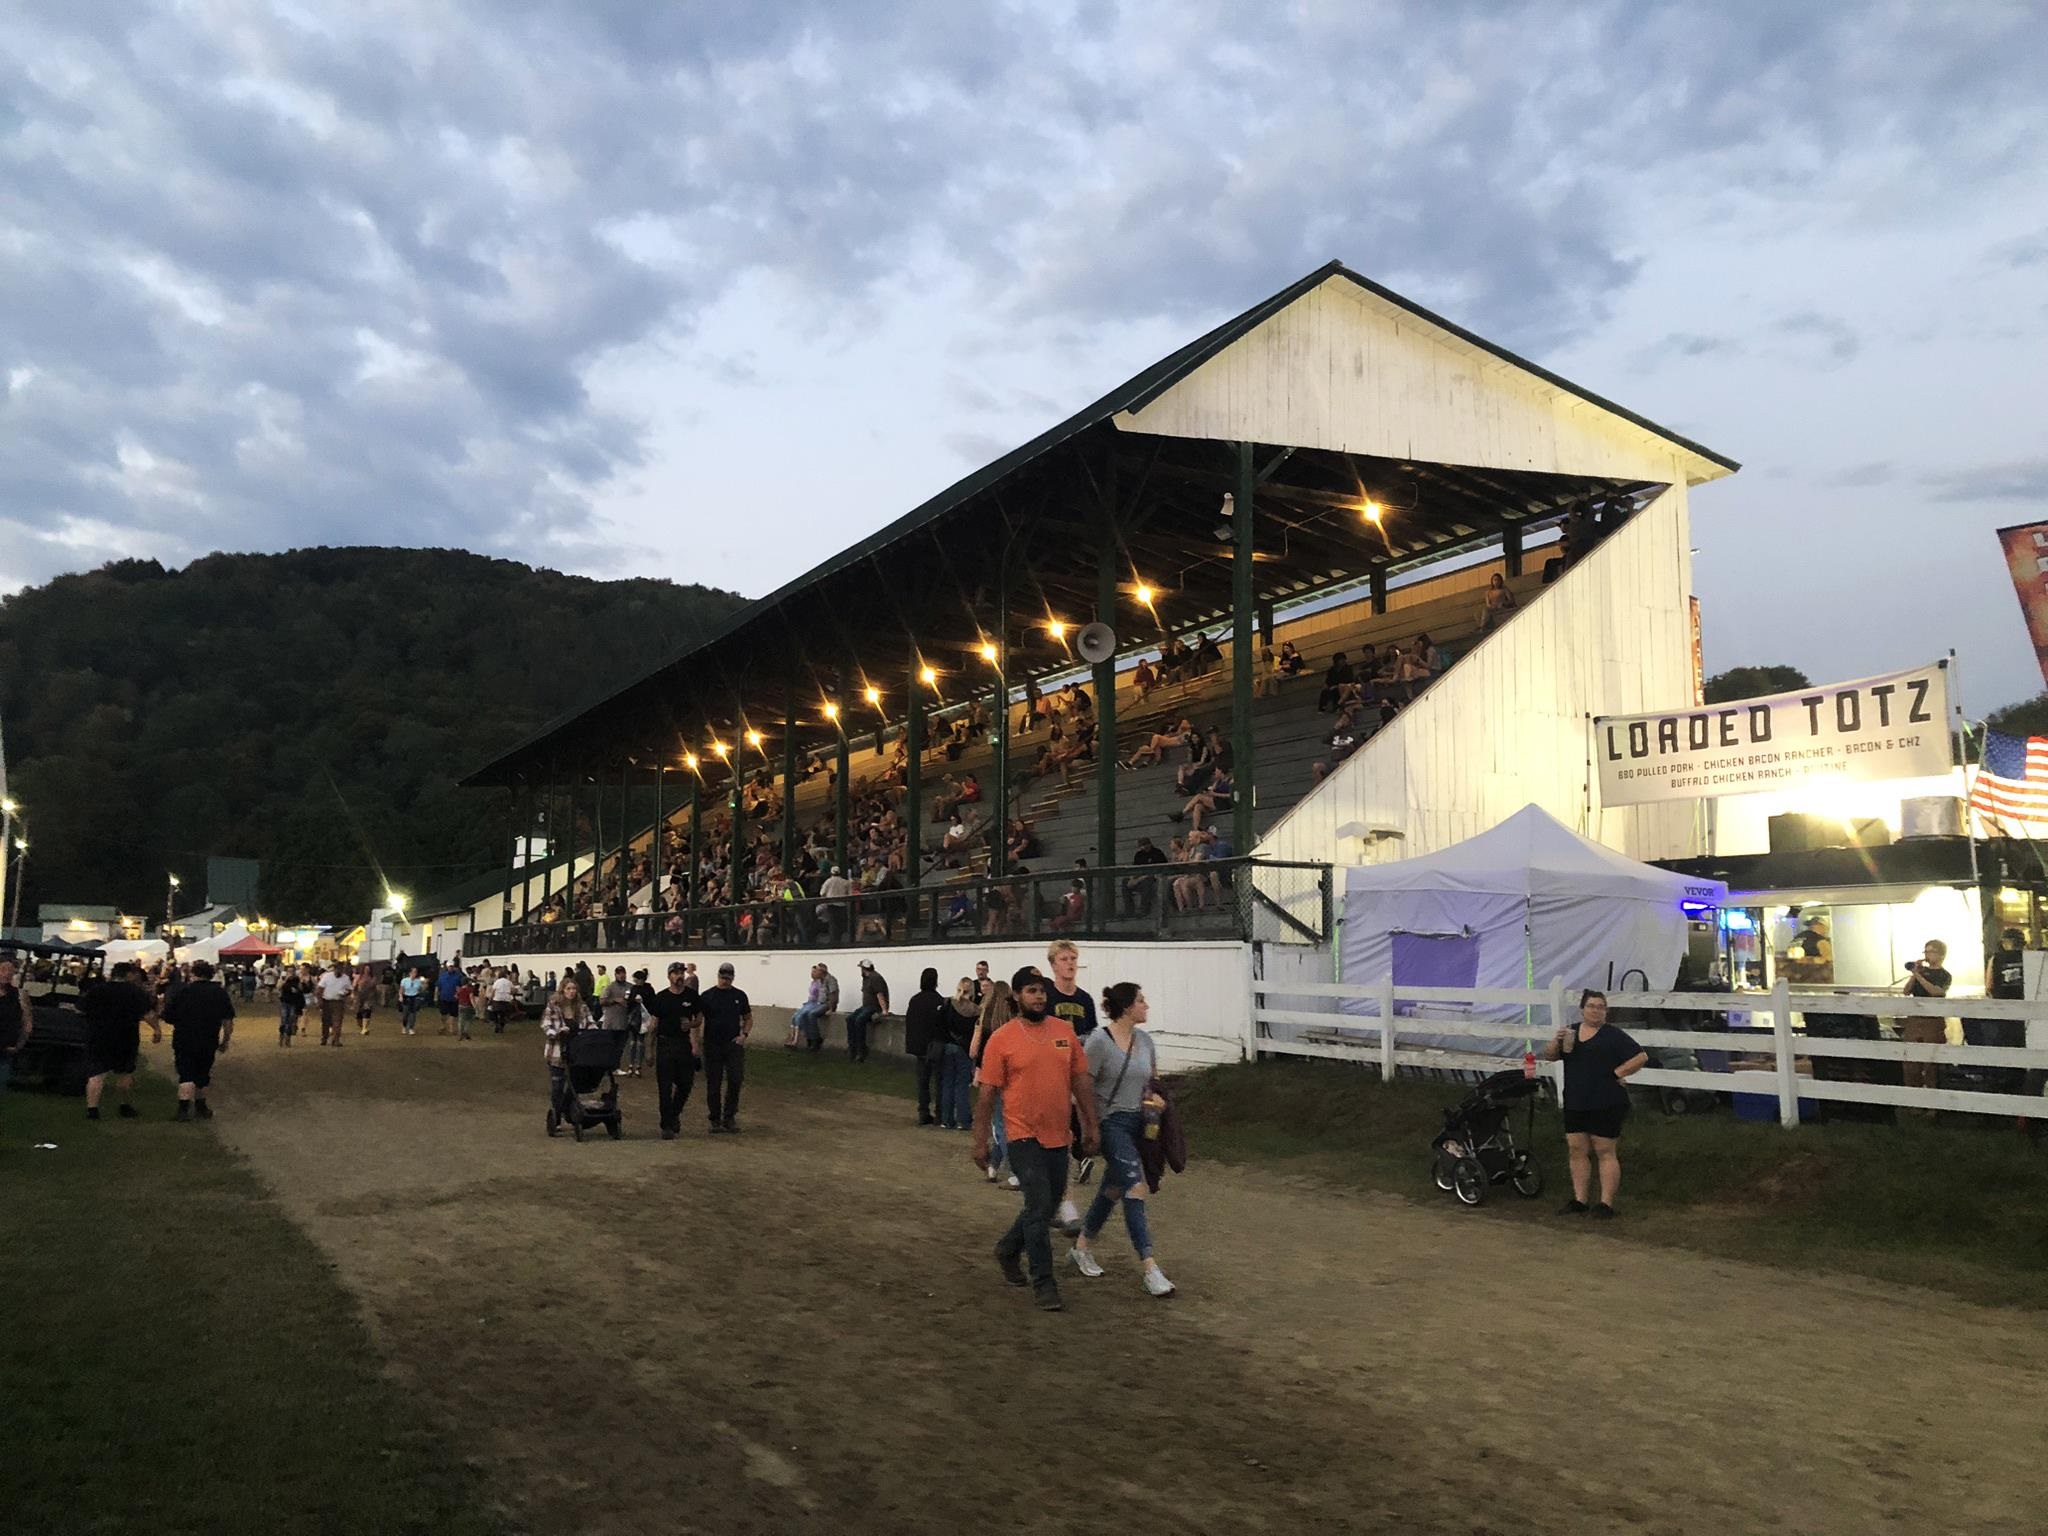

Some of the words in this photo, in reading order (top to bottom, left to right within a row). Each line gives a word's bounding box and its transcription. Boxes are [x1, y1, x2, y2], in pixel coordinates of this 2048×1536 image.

[1607, 704, 1772, 761] LOADED
[1801, 679, 1931, 736] TOTZ
[1637, 765, 1667, 777] PULLED
[1671, 762, 1694, 774] PORK
[1704, 756, 1744, 770] CHICKEN
[1748, 752, 1780, 766] BACON
[1785, 746, 1833, 761] RANCHER
[1845, 740, 1881, 755] BACON
[1886, 739, 1894, 750] &
[1899, 736, 1921, 748] CHZ
[1671, 775, 1709, 788] BUFFALO
[1713, 771, 1754, 785] CHICKEN
[1758, 768, 1792, 780] RANCH
[1684, 886, 1714, 897] VEVOR
